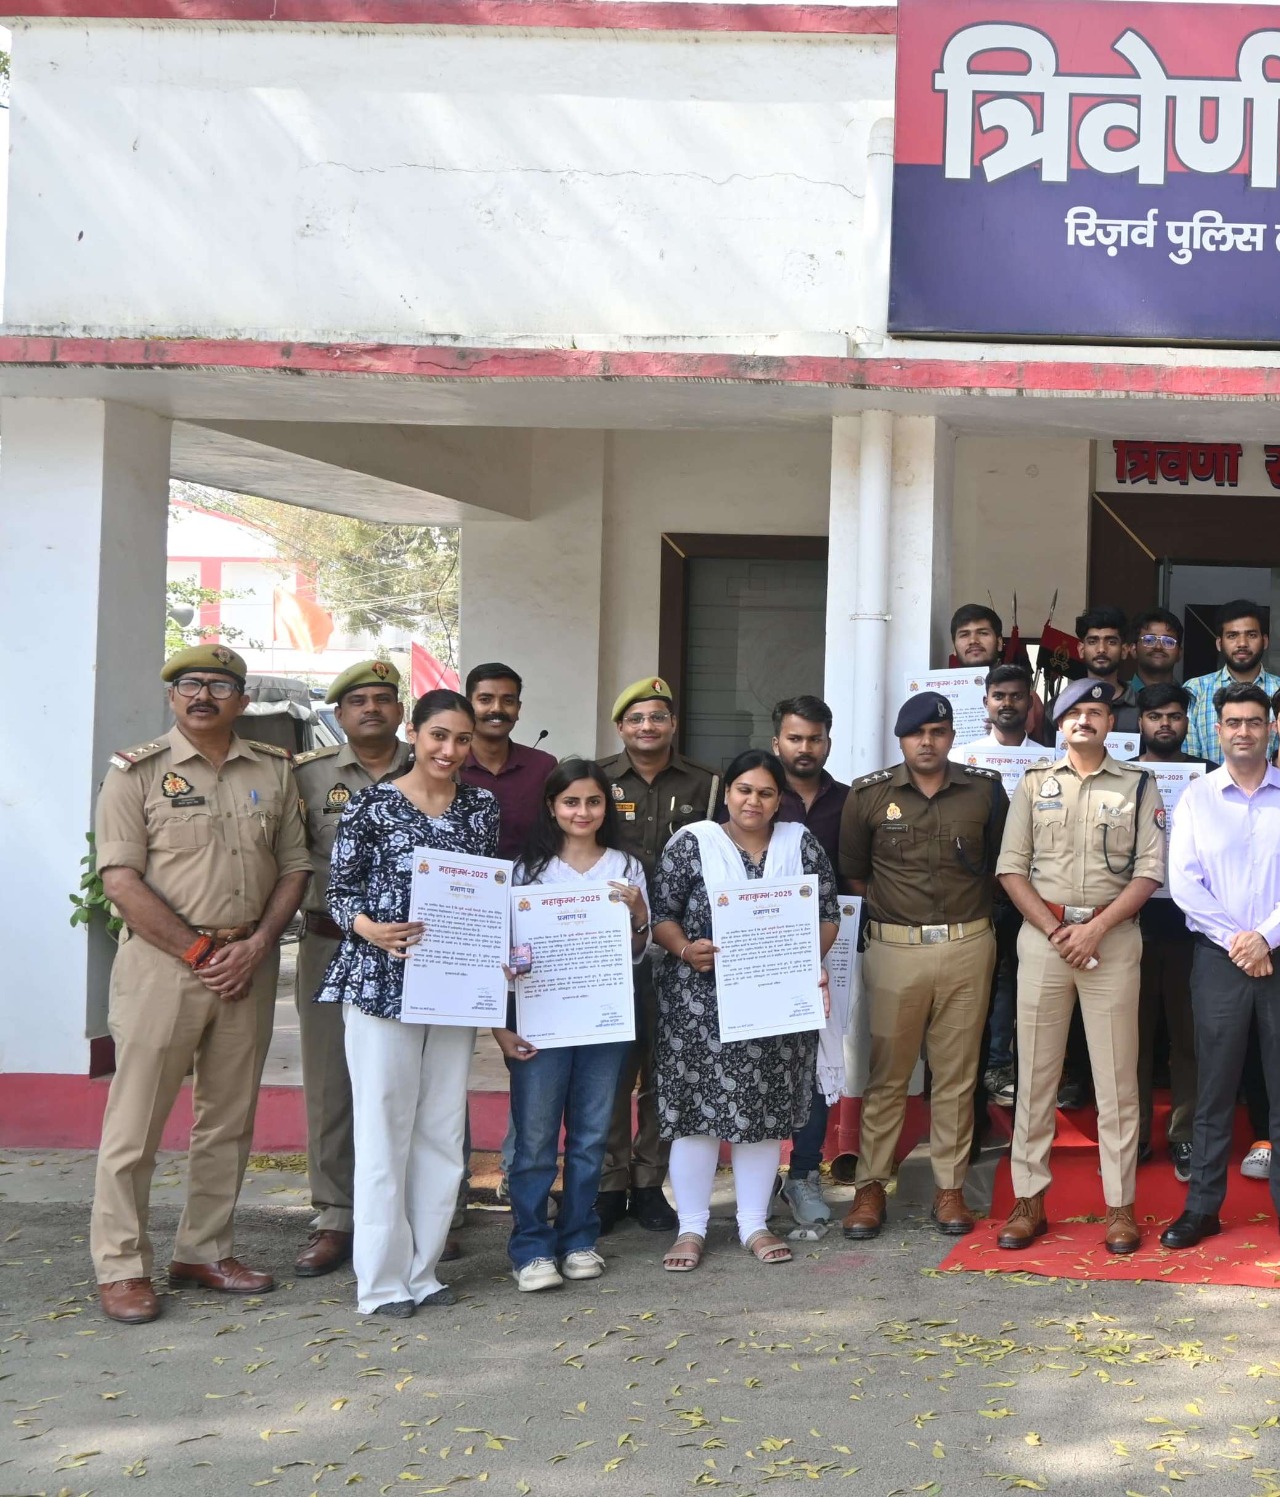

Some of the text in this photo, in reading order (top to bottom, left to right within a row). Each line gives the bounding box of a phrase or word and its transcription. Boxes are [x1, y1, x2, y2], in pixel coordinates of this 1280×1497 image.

[1064, 205, 1159, 257] रिज़र्व
[1165, 209, 1267, 265] पुलिस
[541, 894, 601, 908] महाकुम्भ-2025
[738, 889, 793, 902] महाकुम्भ-2025
